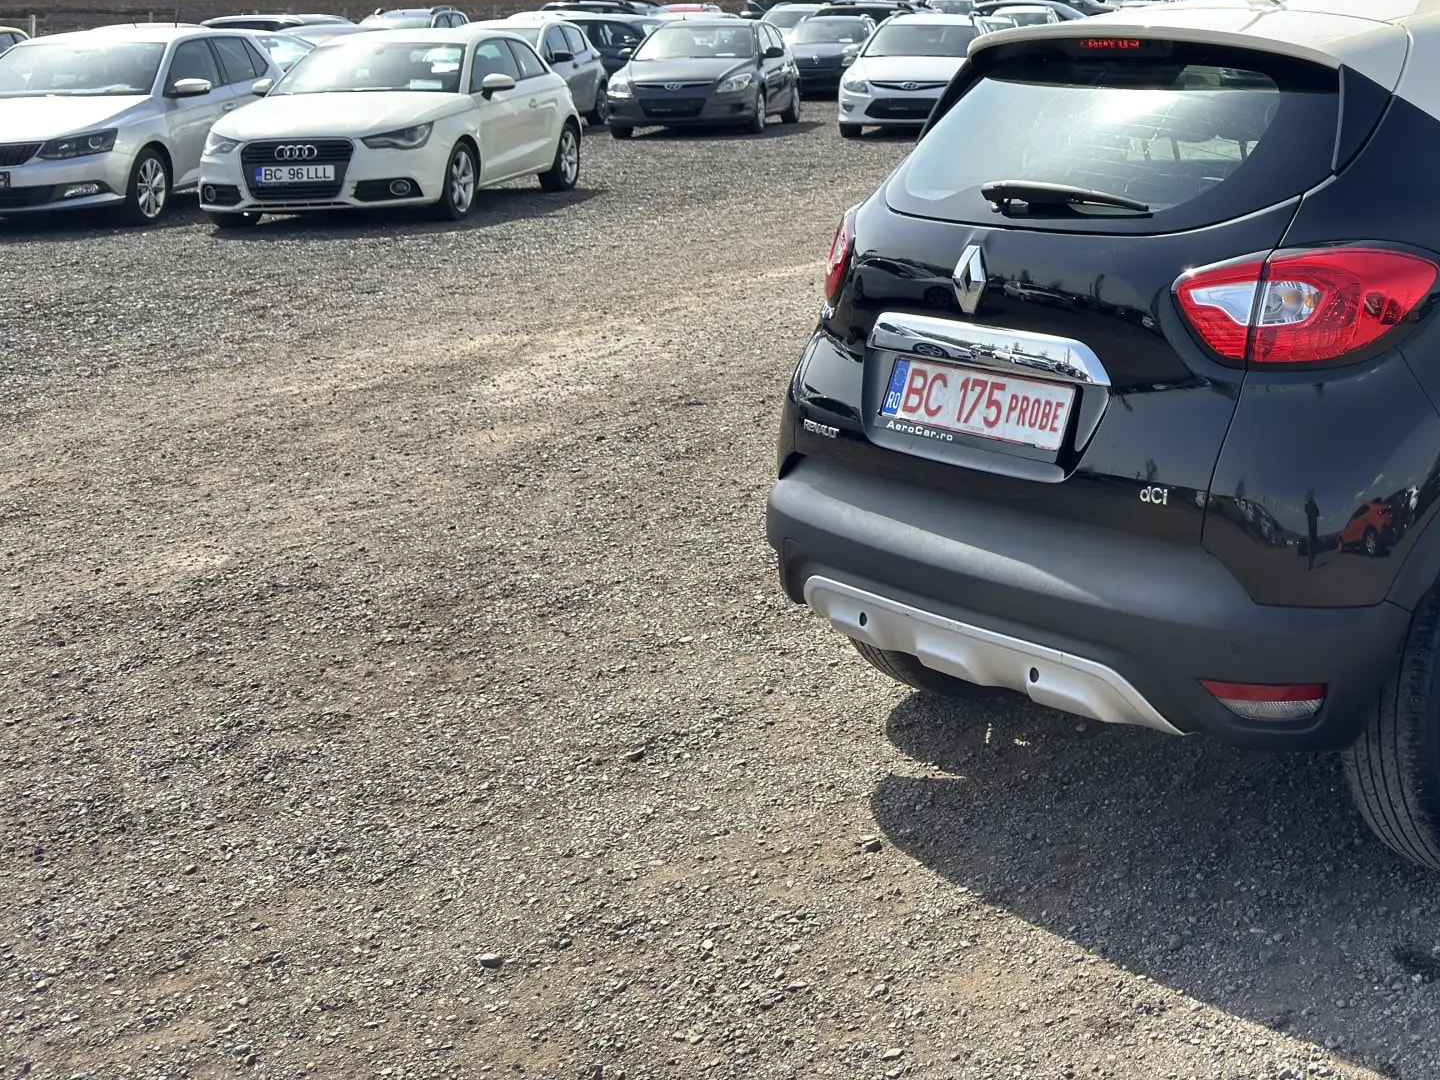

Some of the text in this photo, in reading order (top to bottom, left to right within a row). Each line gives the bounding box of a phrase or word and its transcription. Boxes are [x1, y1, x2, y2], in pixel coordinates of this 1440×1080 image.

[263, 167, 331, 181] BC 96 LLL
[886, 391, 900, 409] RO
[902, 368, 1065, 433] BC 175 PROBE
[803, 418, 840, 439] RENAULT
[886, 420, 953, 442] AeroCar.ro
[1139, 485, 1168, 506] dCi
